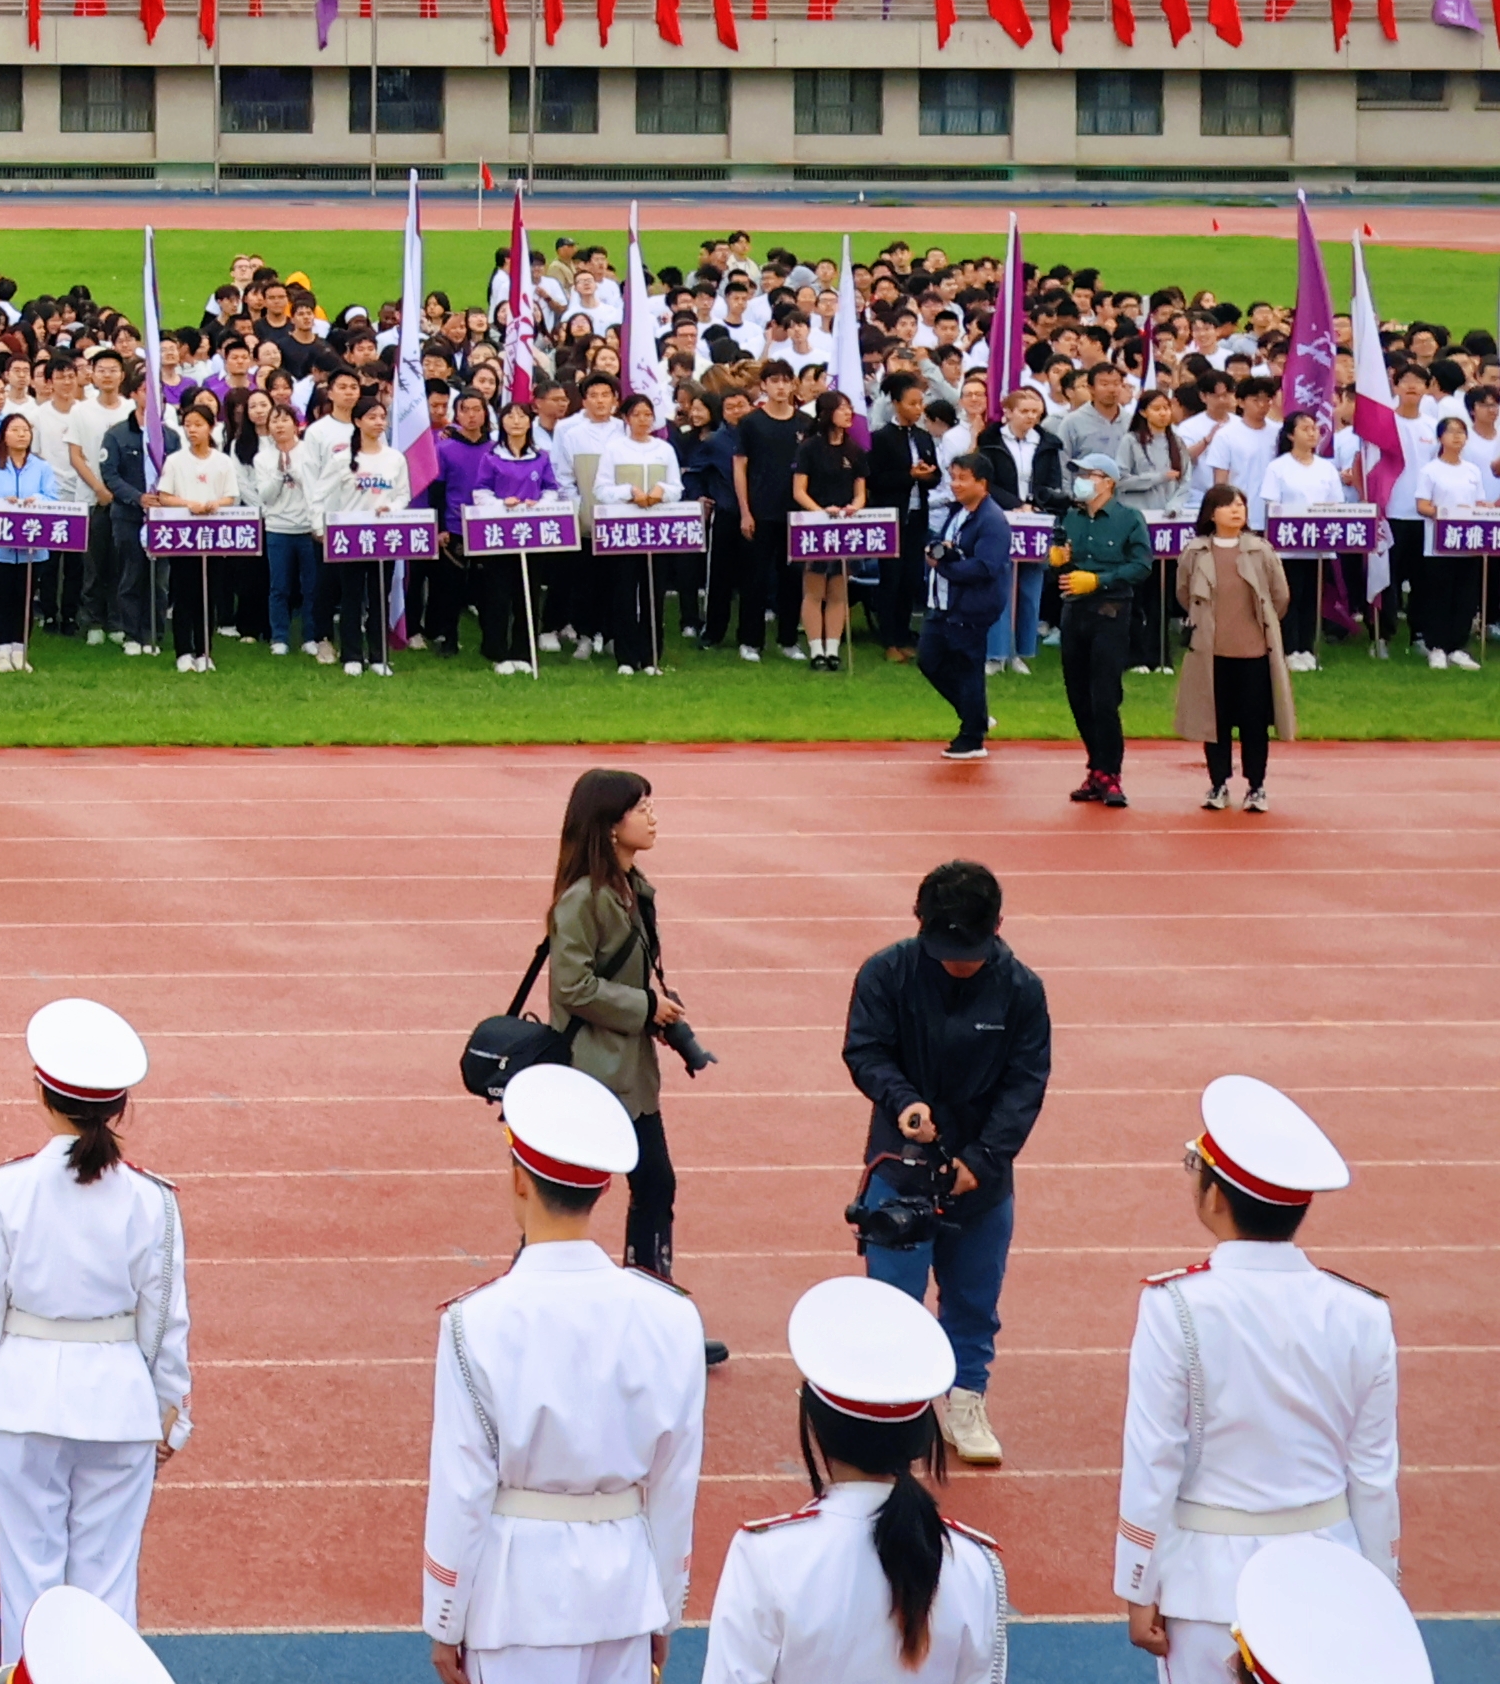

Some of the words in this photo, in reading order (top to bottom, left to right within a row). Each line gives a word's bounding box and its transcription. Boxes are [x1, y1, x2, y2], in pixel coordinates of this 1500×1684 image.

[154, 525, 257, 550] 交叉信息院
[332, 529, 430, 555] 公管学院
[484, 520, 562, 548] 法学院
[595, 520, 703, 548] 马克思主义学院
[800, 527, 887, 554] 社科学院
[1277, 521, 1367, 547] 软件学院
